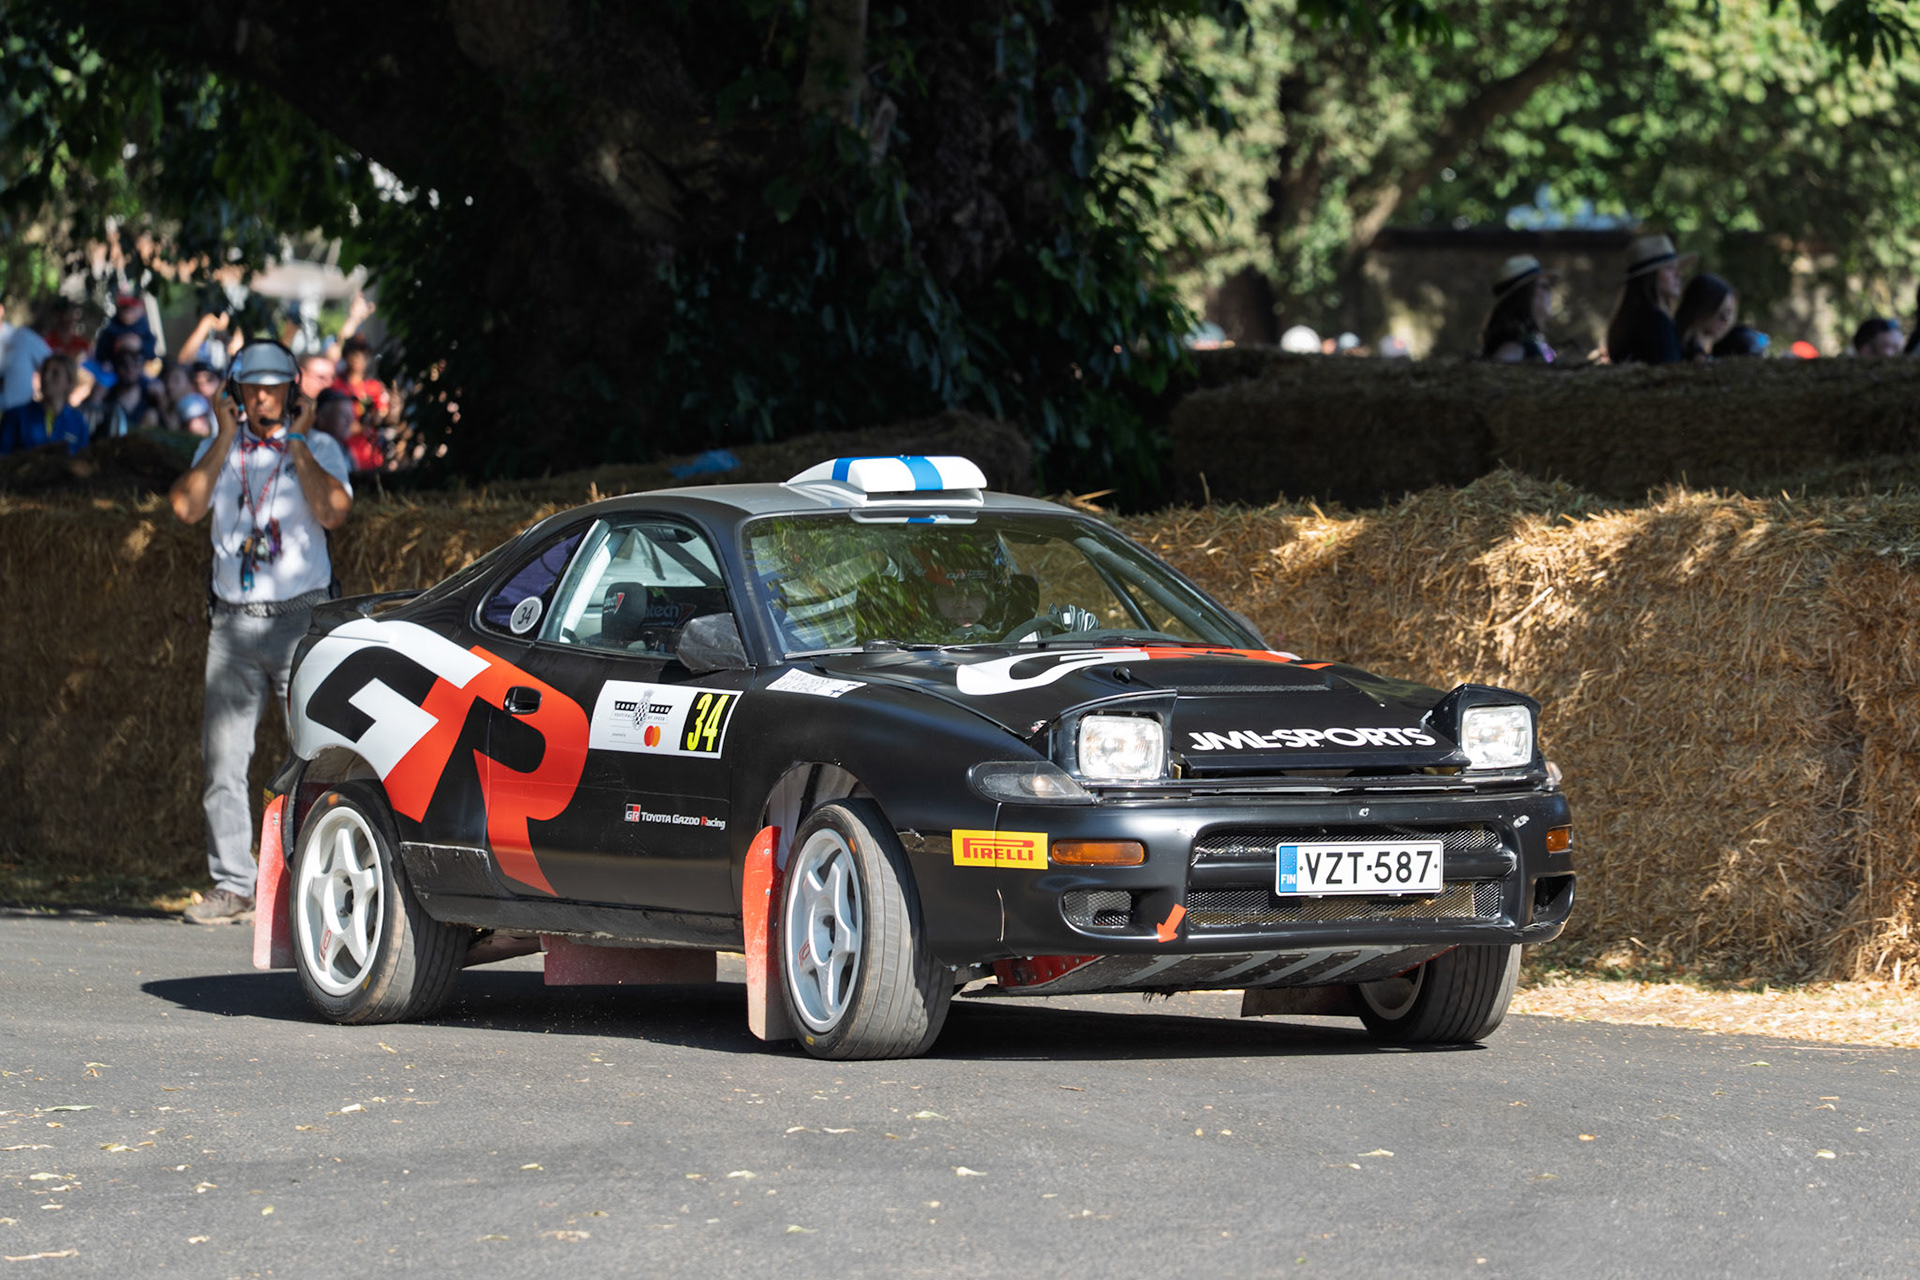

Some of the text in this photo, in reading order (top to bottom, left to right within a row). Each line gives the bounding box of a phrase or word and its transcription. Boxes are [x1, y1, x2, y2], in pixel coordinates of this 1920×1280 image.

[517, 606, 533, 624] 34
[687, 693, 730, 752] 34
[1188, 727, 1437, 751] JML-SPORTS
[290, 618, 590, 897] GR
[641, 811, 671, 824] TOYOTA
[699, 816, 727, 831] Racing
[962, 837, 1035, 861] PIRELLI
[1280, 874, 1297, 884] FIN
